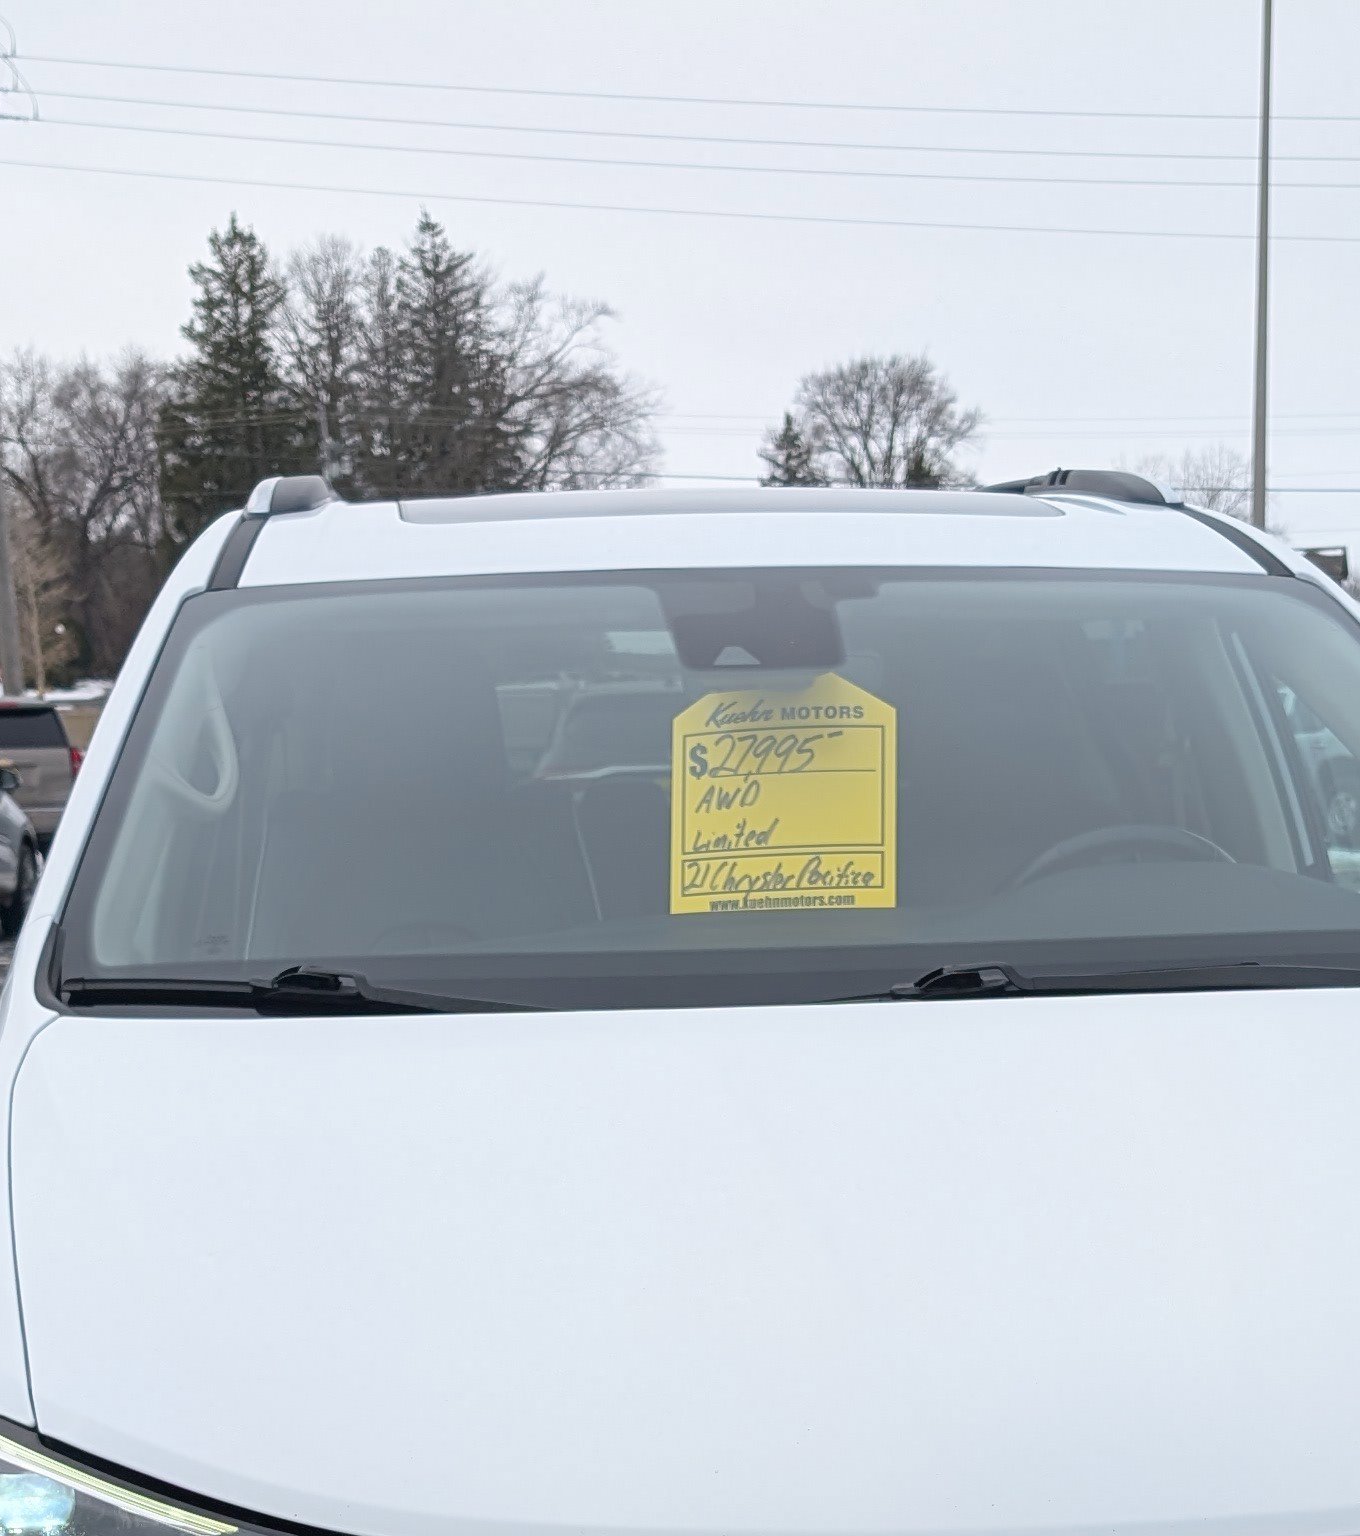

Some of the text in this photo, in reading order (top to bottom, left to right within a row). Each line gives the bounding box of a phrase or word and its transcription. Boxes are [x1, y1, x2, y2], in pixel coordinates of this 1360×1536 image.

[705, 699, 865, 728] Kuehn MOTORS
[695, 779, 760, 813] AWD
[692, 817, 780, 851] Limited
[682, 862, 711, 893] 21
